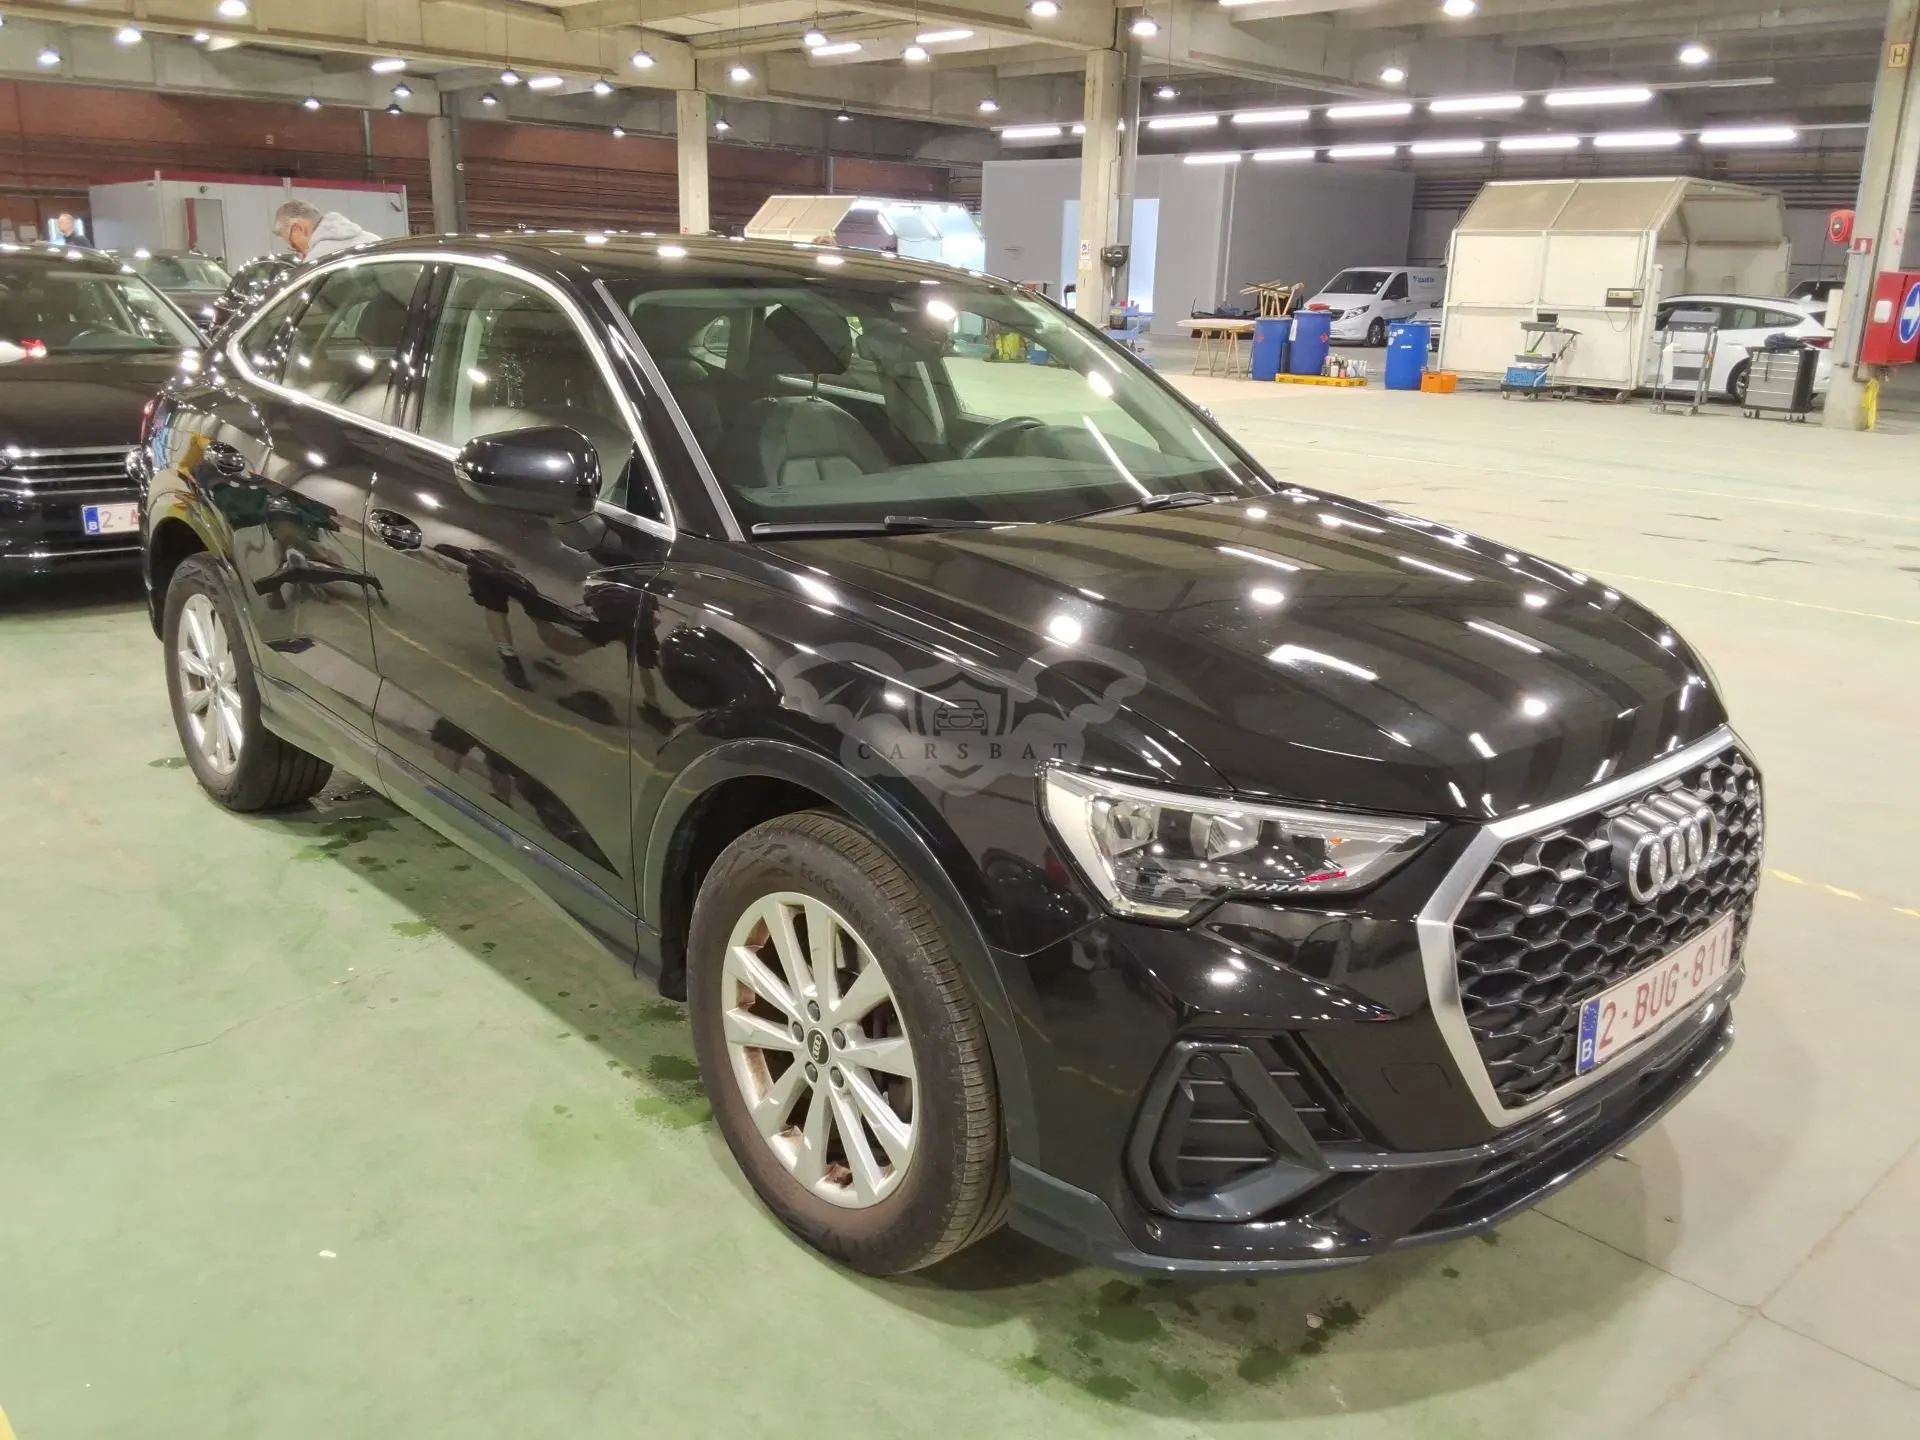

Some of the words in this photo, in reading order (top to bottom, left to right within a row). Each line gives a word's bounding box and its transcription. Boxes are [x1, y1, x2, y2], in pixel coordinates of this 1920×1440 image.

[1893, 47, 1905, 64] H
[1581, 1038, 1593, 1062] B
[1599, 926, 1729, 1050] 2-BUG-811
